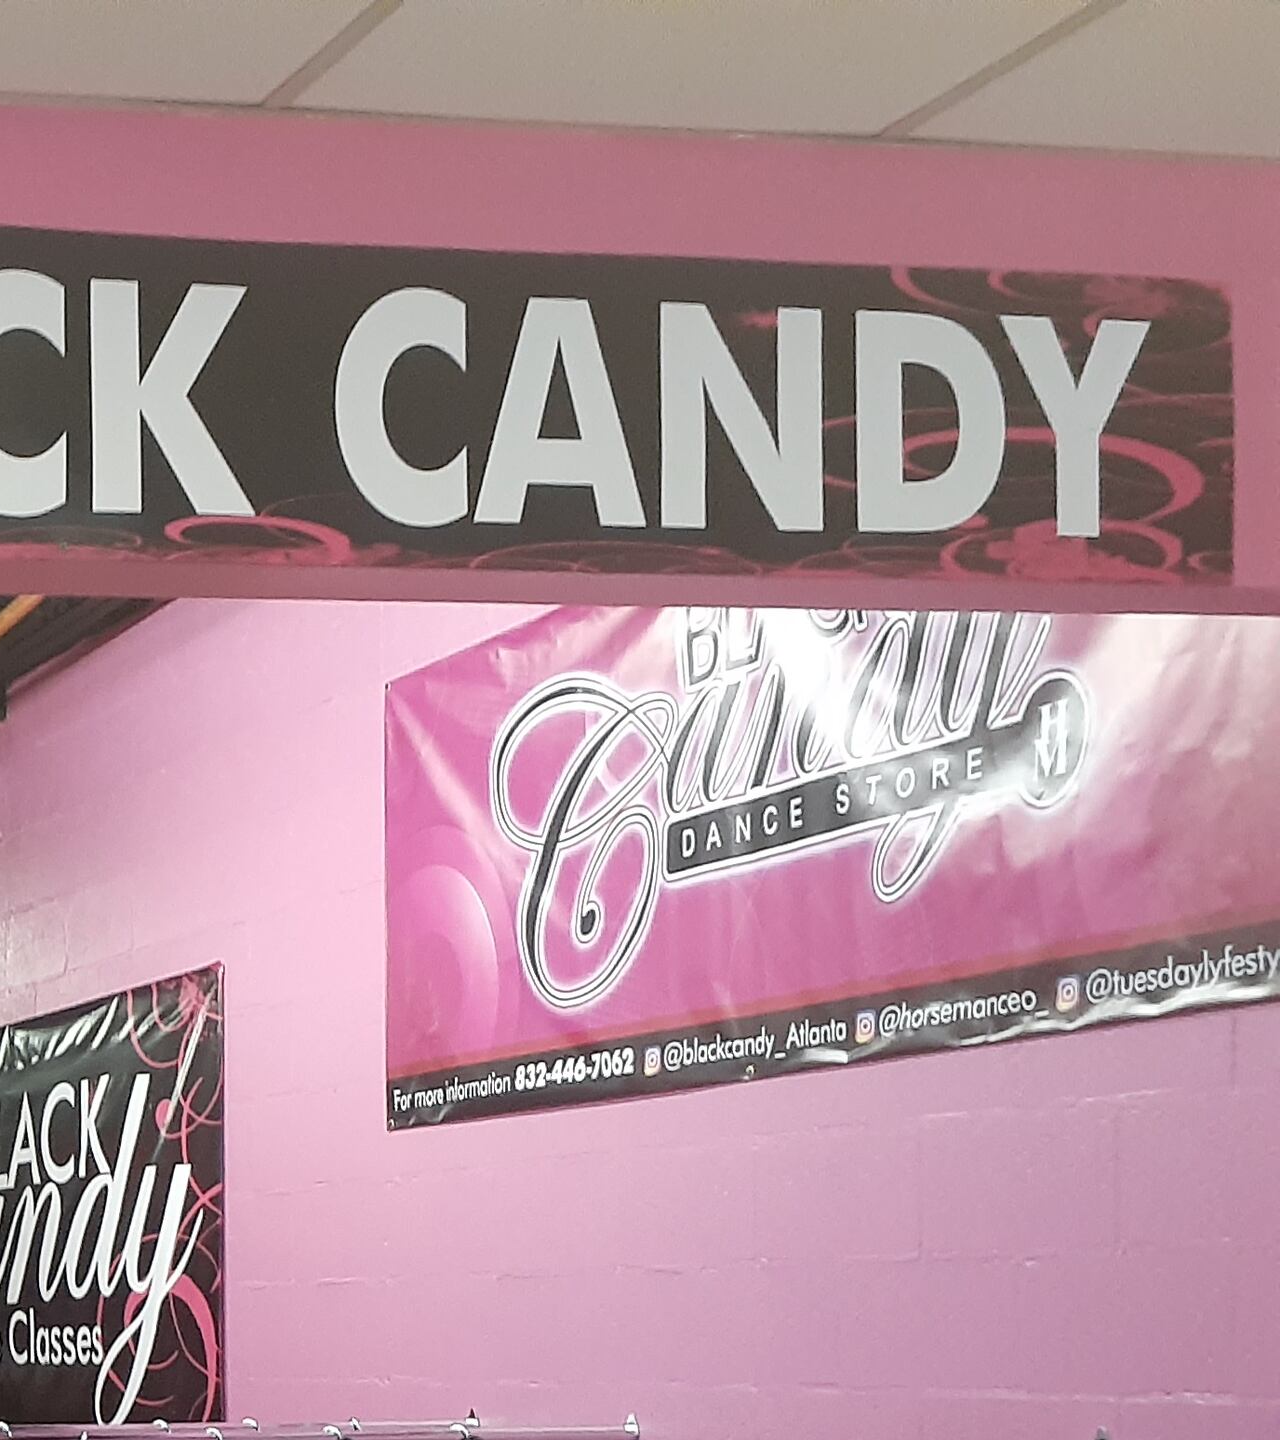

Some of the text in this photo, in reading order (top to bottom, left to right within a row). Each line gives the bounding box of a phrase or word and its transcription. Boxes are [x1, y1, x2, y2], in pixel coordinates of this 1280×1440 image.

[333, 286, 1153, 540] CANDY
[680, 744, 987, 861] DANCE STORE
[392, 1086, 413, 1112] For
[413, 1077, 444, 1110] more
[445, 1072, 513, 1103] information
[514, 1047, 635, 1091] 832-446-7062
[663, 1017, 848, 1071] @blackcandy_Atlanta
[878, 988, 1050, 1038] @horsemanceo_
[8, 1307, 104, 1366] Classes
